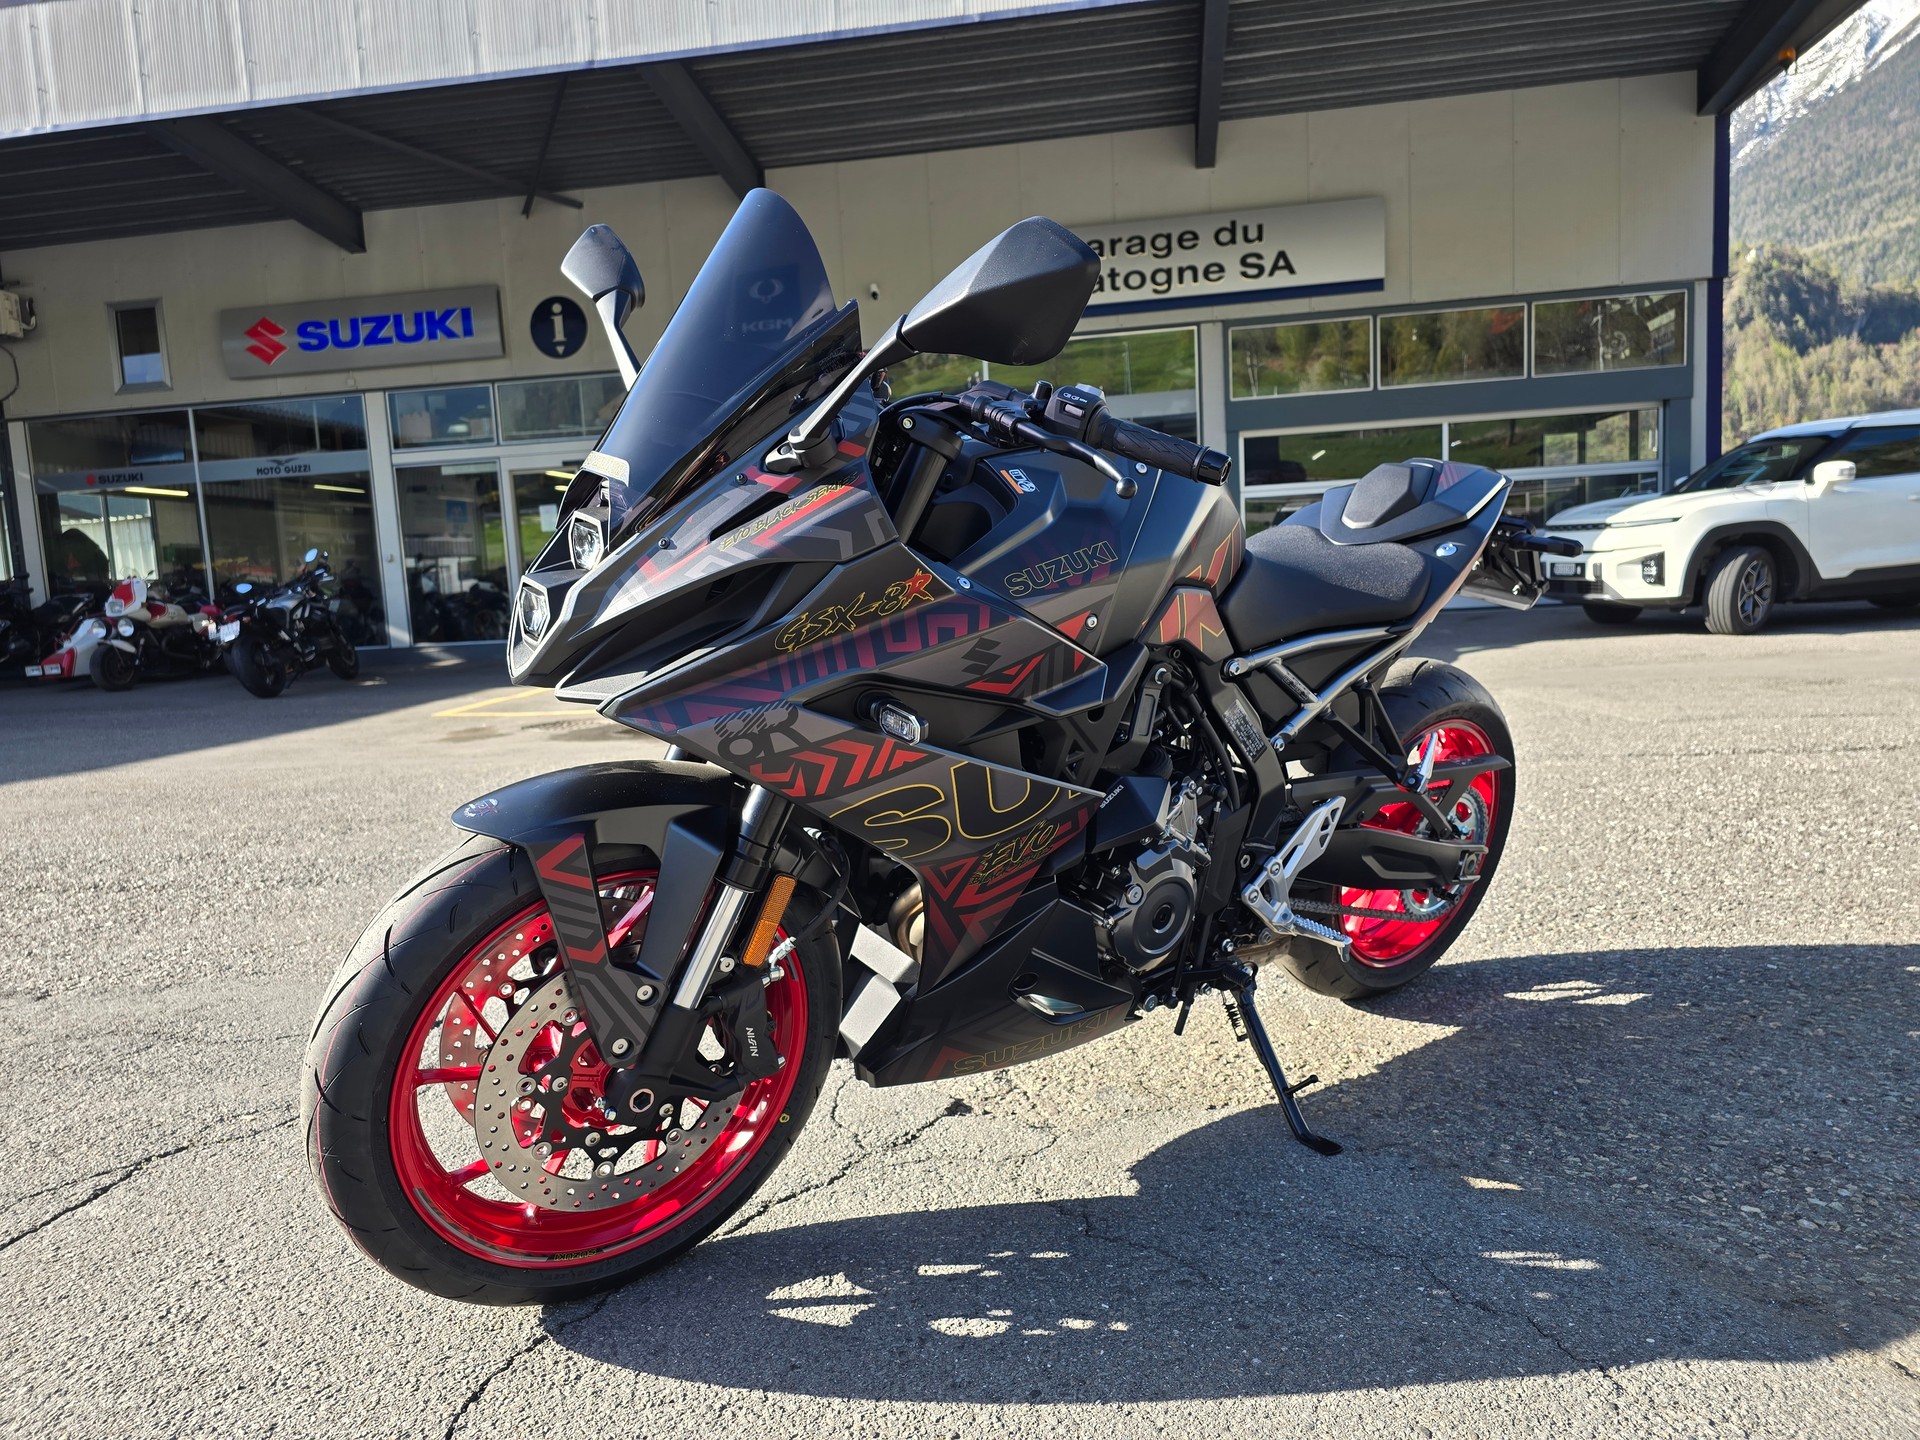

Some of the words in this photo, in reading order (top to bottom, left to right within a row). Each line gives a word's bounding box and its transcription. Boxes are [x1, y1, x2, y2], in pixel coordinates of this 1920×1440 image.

[1087, 229, 1200, 259] arage
[1213, 220, 1264, 247] du
[1092, 261, 1226, 295] atogne
[1239, 250, 1297, 279] SA
[296, 306, 475, 353] SUZUKI
[741, 317, 794, 333] KGM
[97, 472, 144, 485] SUZUKI
[256, 466, 281, 476] MOTO
[284, 464, 311, 474] GUZZI
[719, 527, 751, 552] EVO
[752, 500, 804, 535] BLACK
[1004, 541, 1119, 597] SUZUKI
[774, 568, 935, 653] GSX-8R
[829, 761, 1082, 859] SU
[1099, 784, 1125, 809] SUZUKI
[975, 819, 1060, 878] EVO
[953, 1009, 1110, 1076] SUZUKI
